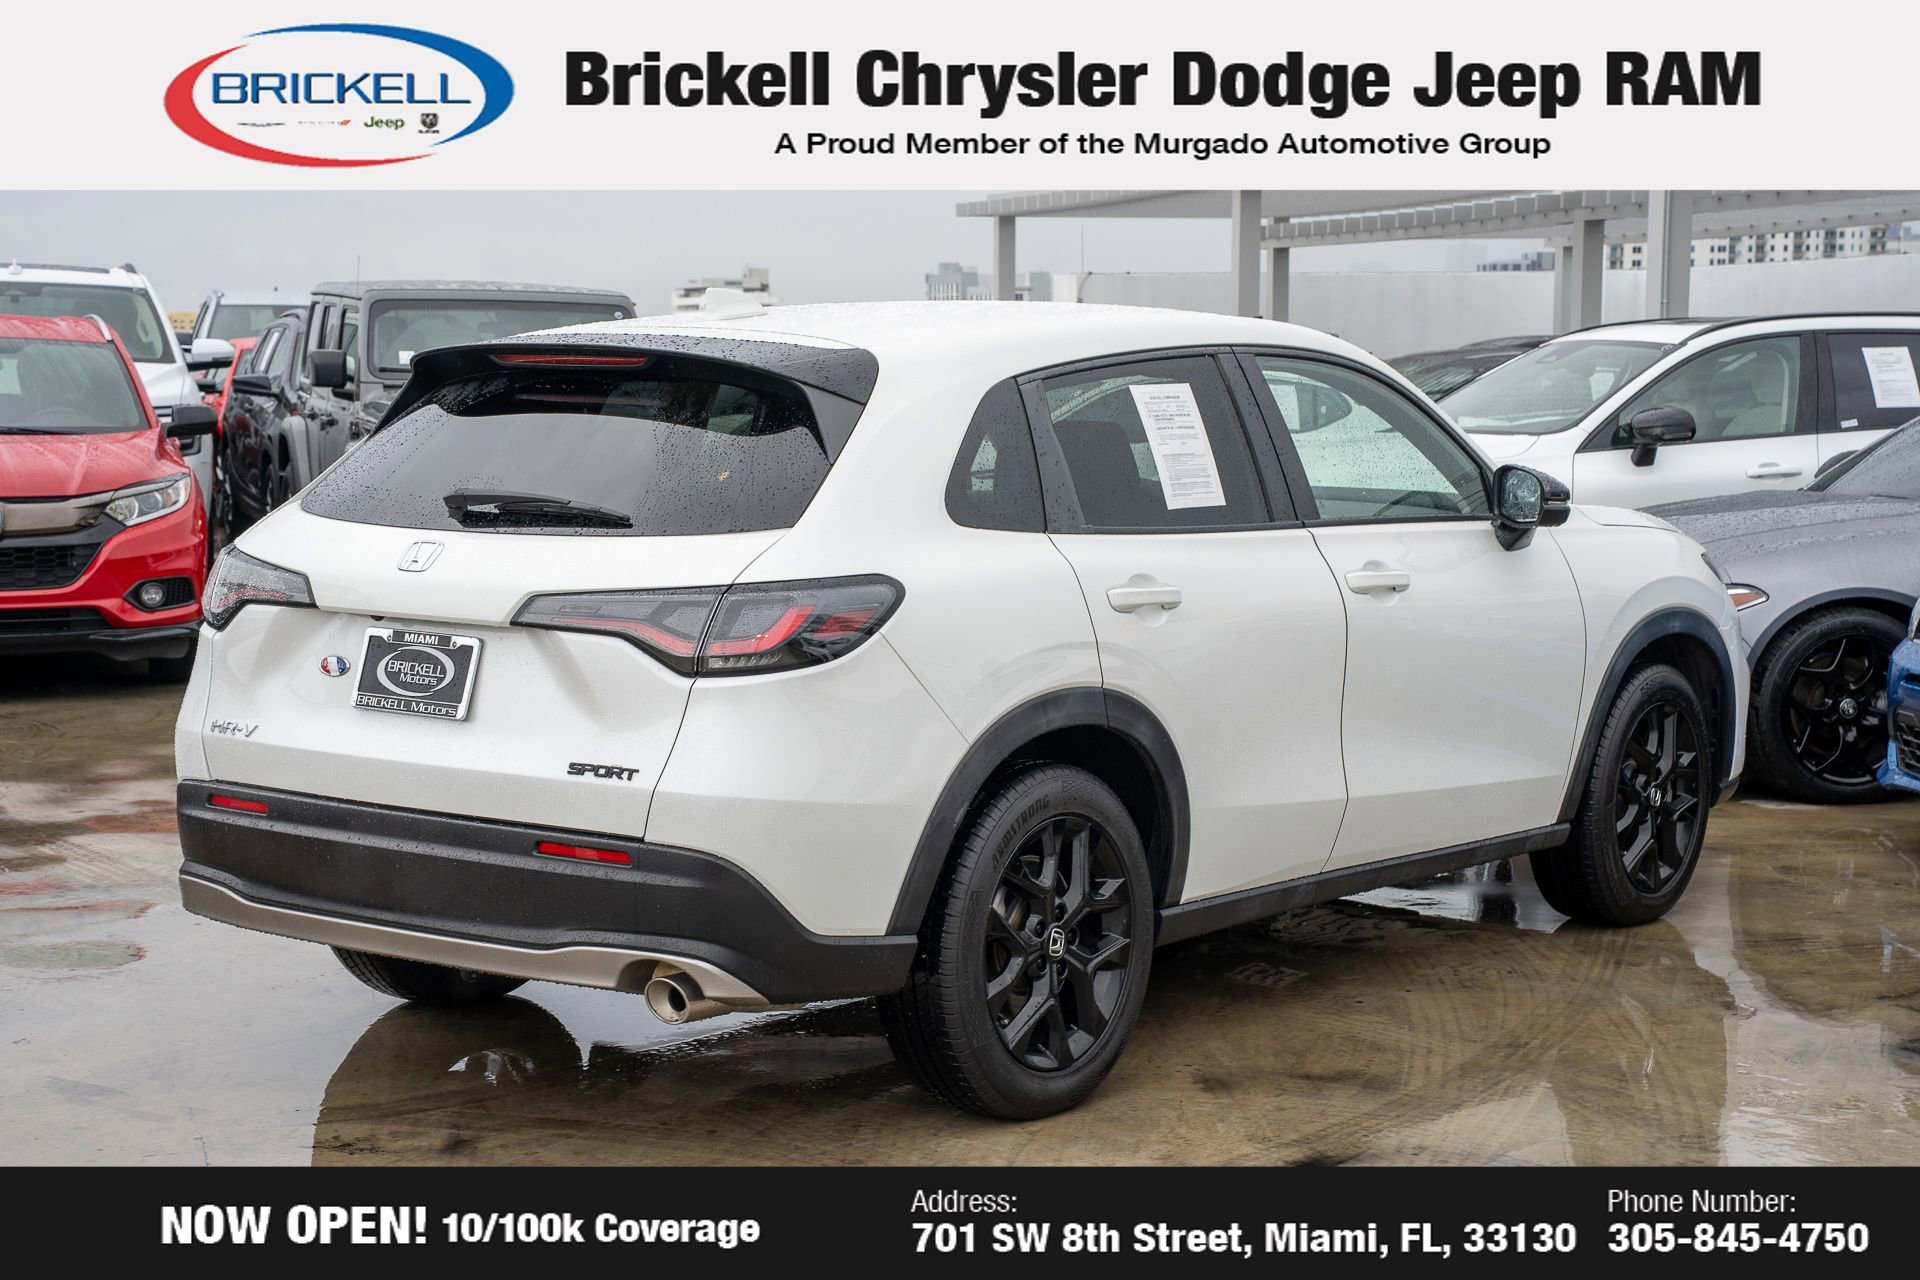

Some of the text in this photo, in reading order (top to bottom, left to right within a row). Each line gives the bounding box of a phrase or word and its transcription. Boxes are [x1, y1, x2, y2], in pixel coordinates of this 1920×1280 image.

[404, 633, 439, 646] MIAMI
[387, 660, 445, 678] BRICKELL
[399, 674, 438, 686] Motors
[356, 695, 457, 717] BRICKELL Motors
[567, 762, 640, 782] SPORT
